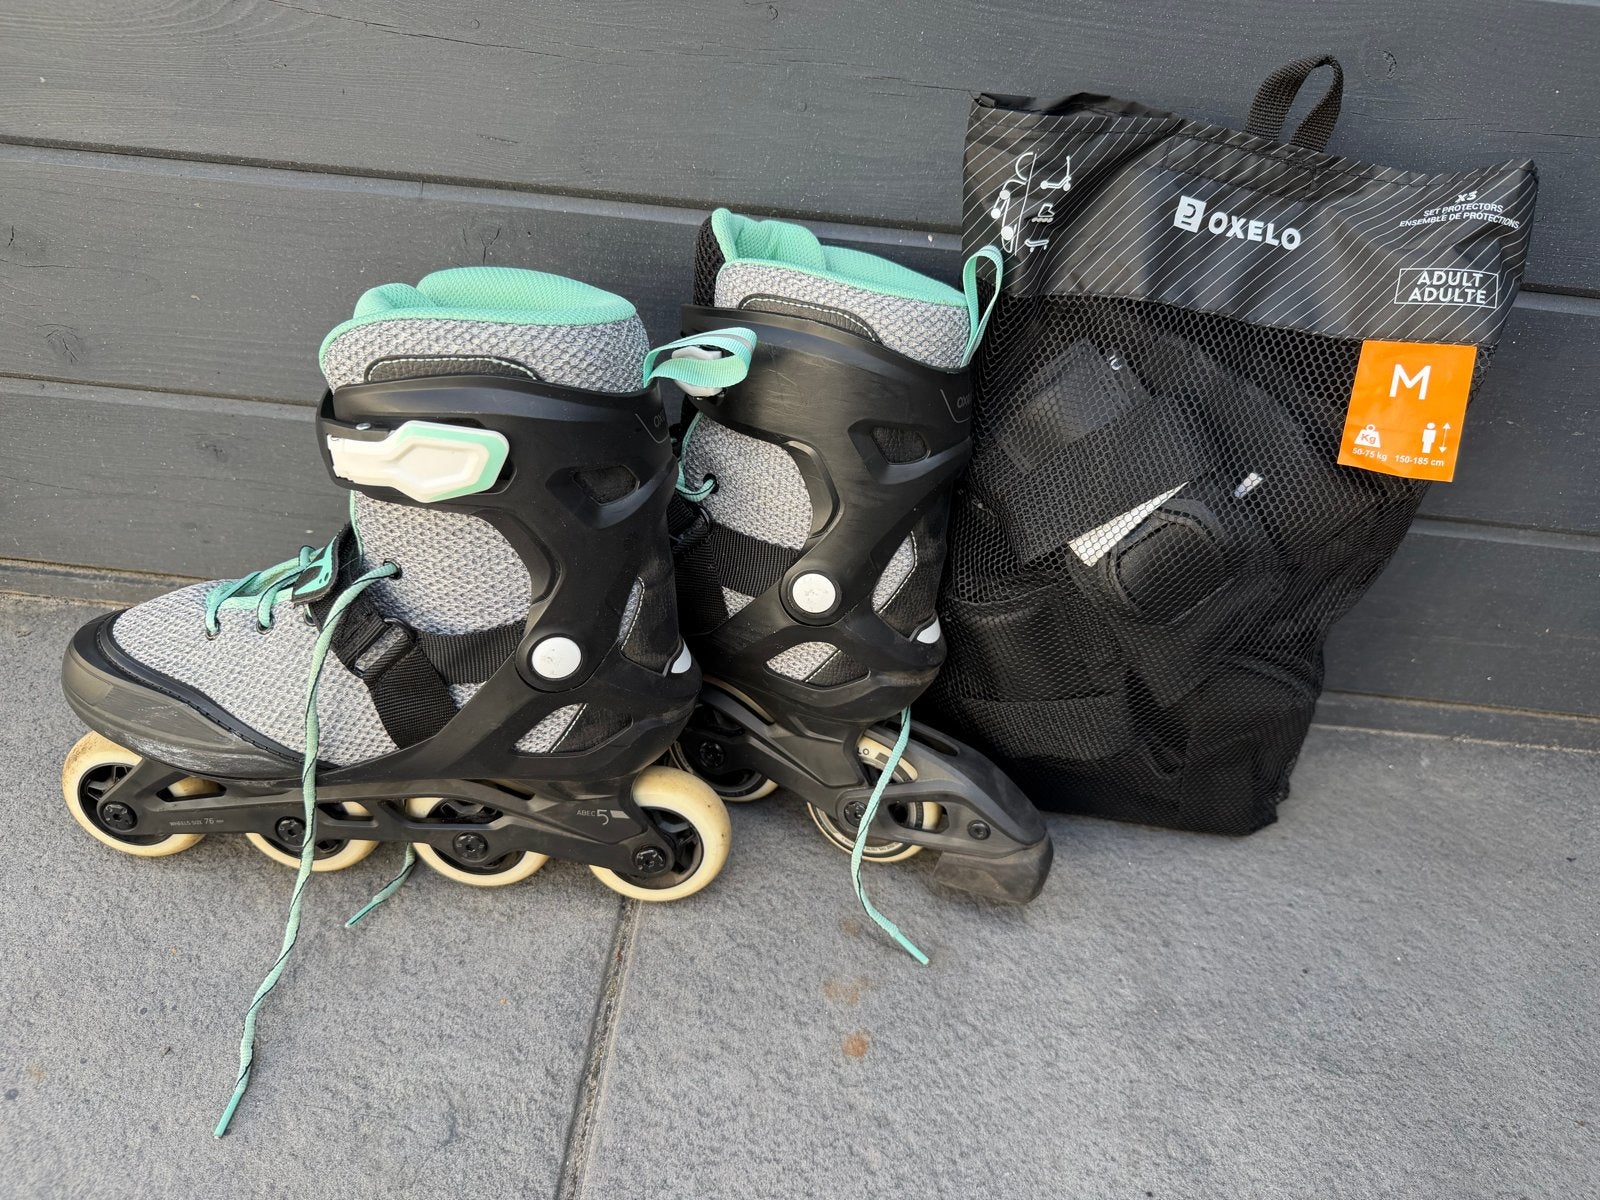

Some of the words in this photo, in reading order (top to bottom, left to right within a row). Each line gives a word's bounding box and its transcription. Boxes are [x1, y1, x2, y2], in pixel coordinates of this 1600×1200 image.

[1423, 208, 1442, 217] SET
[1442, 202, 1503, 214] PROTECTORS
[1399, 214, 1447, 228] ENSEMBLE
[1448, 212, 1461, 221] DE
[1463, 212, 1520, 229] PROTECTIONS
[1208, 211, 1301, 251] OXELO
[1416, 271, 1484, 288] ADULT
[1408, 287, 1487, 304] ADULTE
[1389, 363, 1432, 401] M
[1352, 447, 1375, 458] 50-75
[1376, 452, 1388, 462] kg
[1395, 454, 1429, 466] 150-185
[1430, 459, 1445, 467] cm
[203, 817, 215, 825] 76
[596, 808, 610, 826] 5
